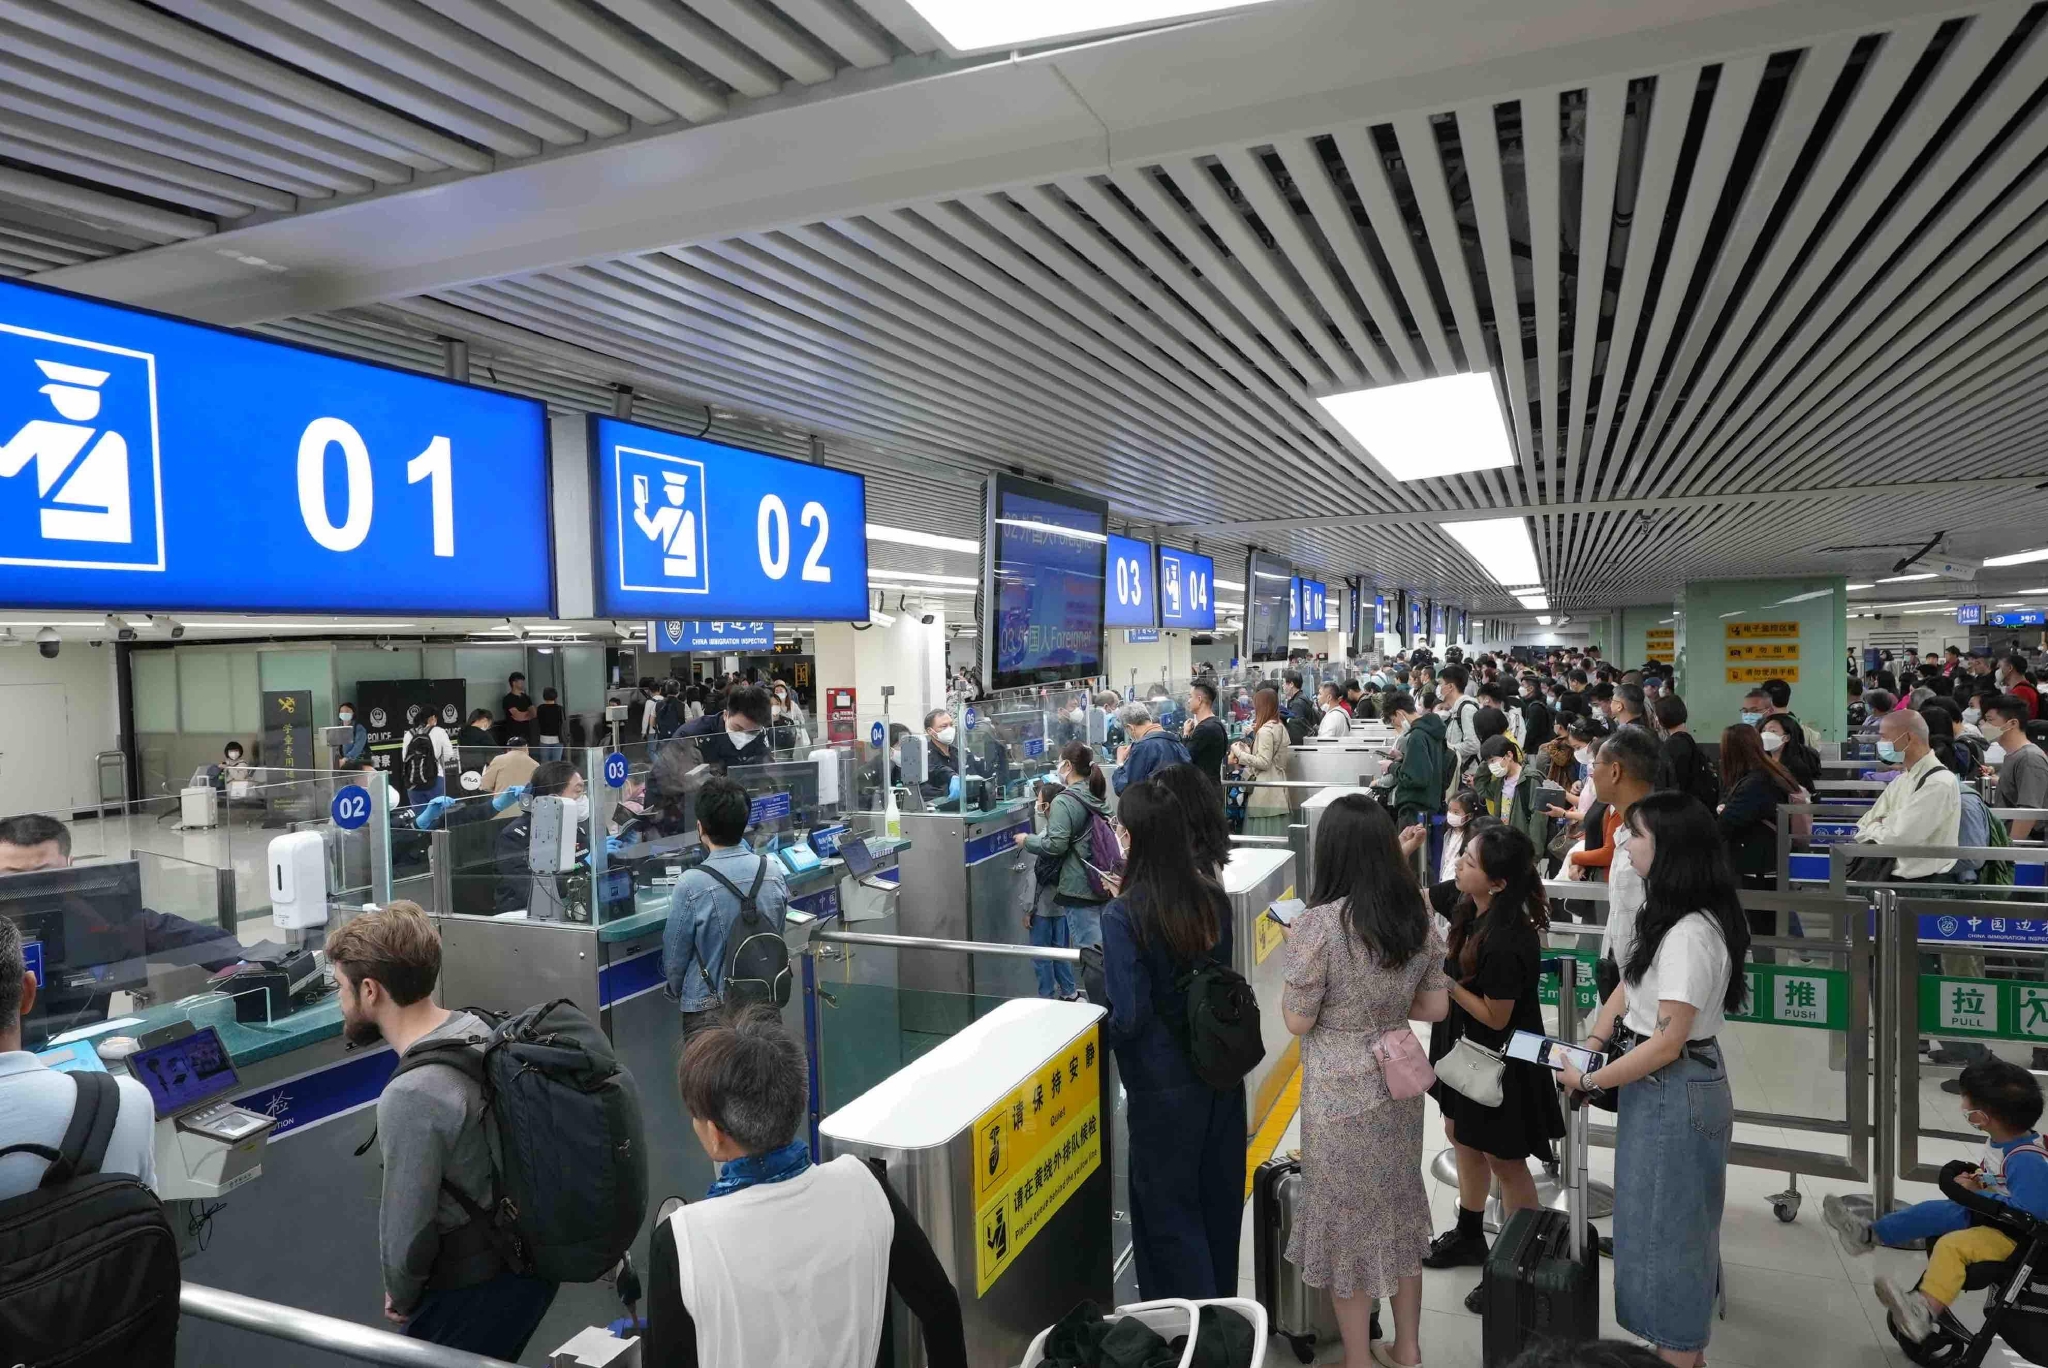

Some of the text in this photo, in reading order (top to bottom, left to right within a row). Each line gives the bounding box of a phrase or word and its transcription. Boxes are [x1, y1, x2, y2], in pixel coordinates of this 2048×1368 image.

[297, 416, 454, 558] 01
[757, 493, 832, 584] 02
[1116, 556, 1142, 606] 03
[1189, 570, 1207, 611] 04
[1314, 593, 1323, 620] 06
[709, 637, 740, 645] IMMIGRATION
[741, 637, 768, 645] INSPECTION
[1001, 627, 1016, 653] 03
[966, 712, 975, 725] 05
[872, 726, 882, 741] 04
[371, 754, 391, 768] 警察
[609, 761, 625, 779] 03
[463, 776, 478, 784] FILA
[340, 796, 365, 819] 02
[1785, 980, 1816, 1008] 推
[1952, 987, 1986, 1015] 拉
[1784, 1009, 1816, 1019] PUSH
[1951, 1017, 1984, 1027] PULL
[1012, 1041, 1095, 1132] 请保持安静
[1050, 1105, 1066, 1127] Quiet
[1014, 1114, 1097, 1214] 请在黄线外排队候检
[1015, 1148, 1098, 1240] Please queue behind the yellow line
